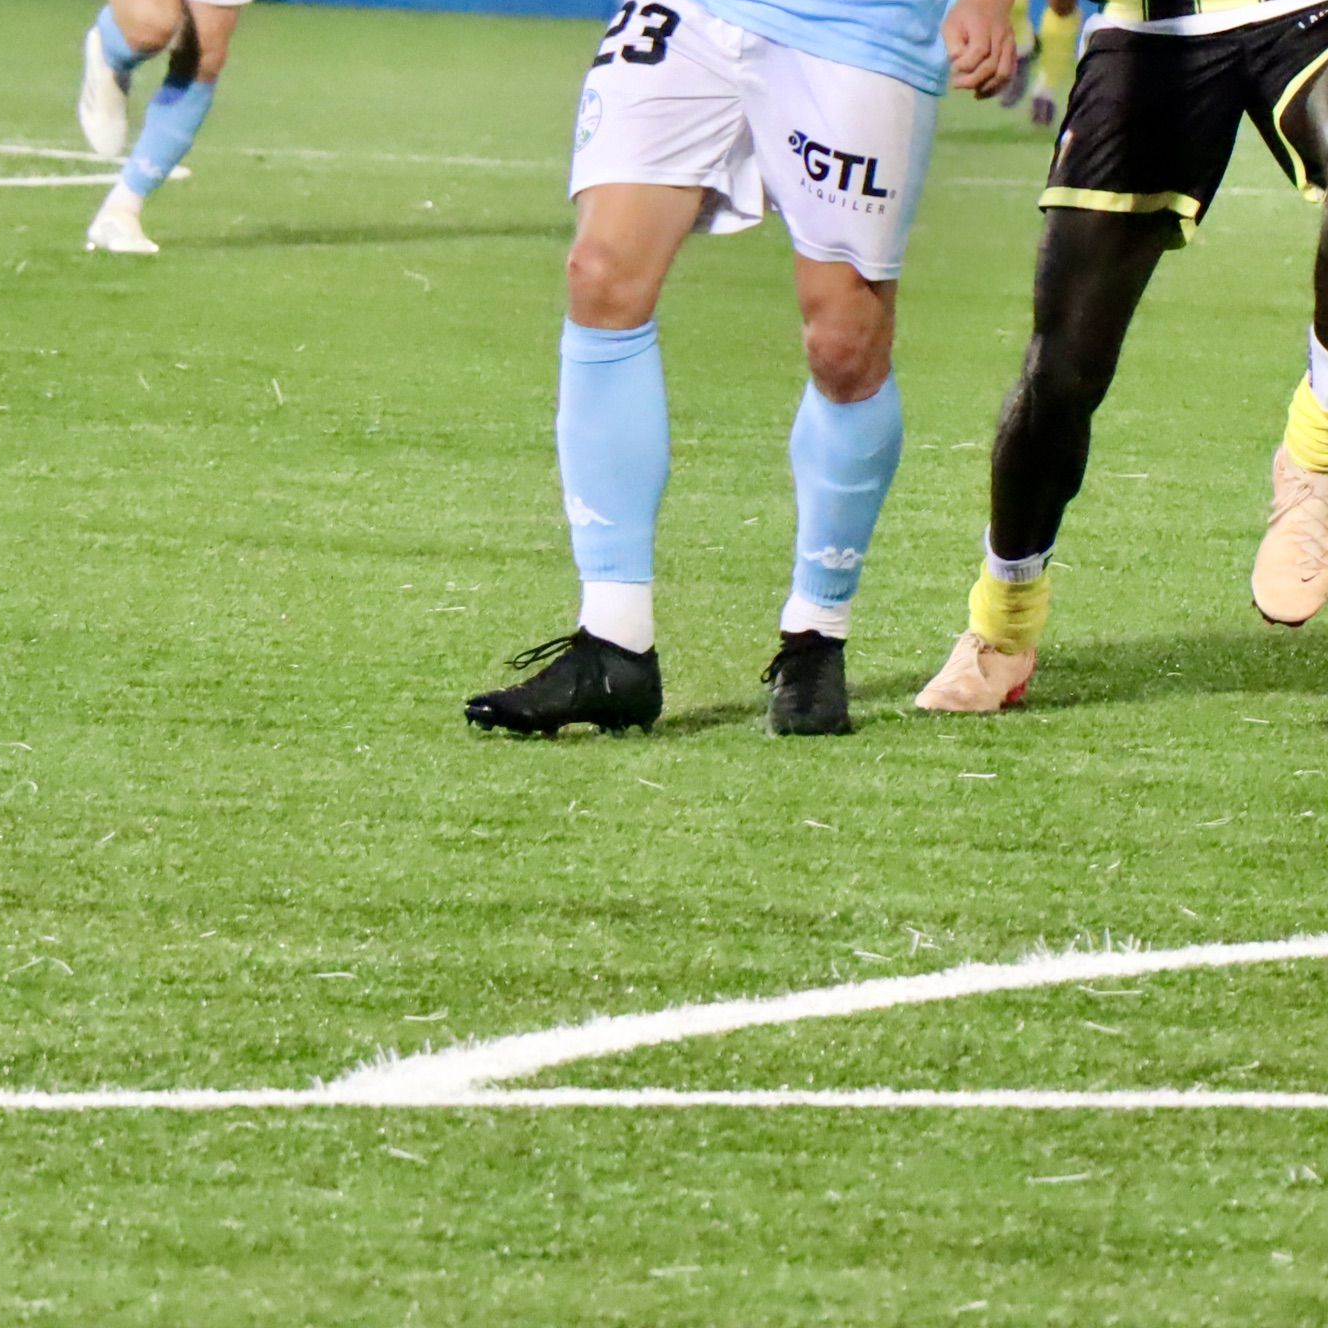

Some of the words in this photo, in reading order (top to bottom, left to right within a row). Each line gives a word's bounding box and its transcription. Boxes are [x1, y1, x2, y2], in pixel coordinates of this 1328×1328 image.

[592, 0, 681, 68] 23
[800, 177, 885, 215] ALQUILER
[803, 141, 887, 198] GTL
